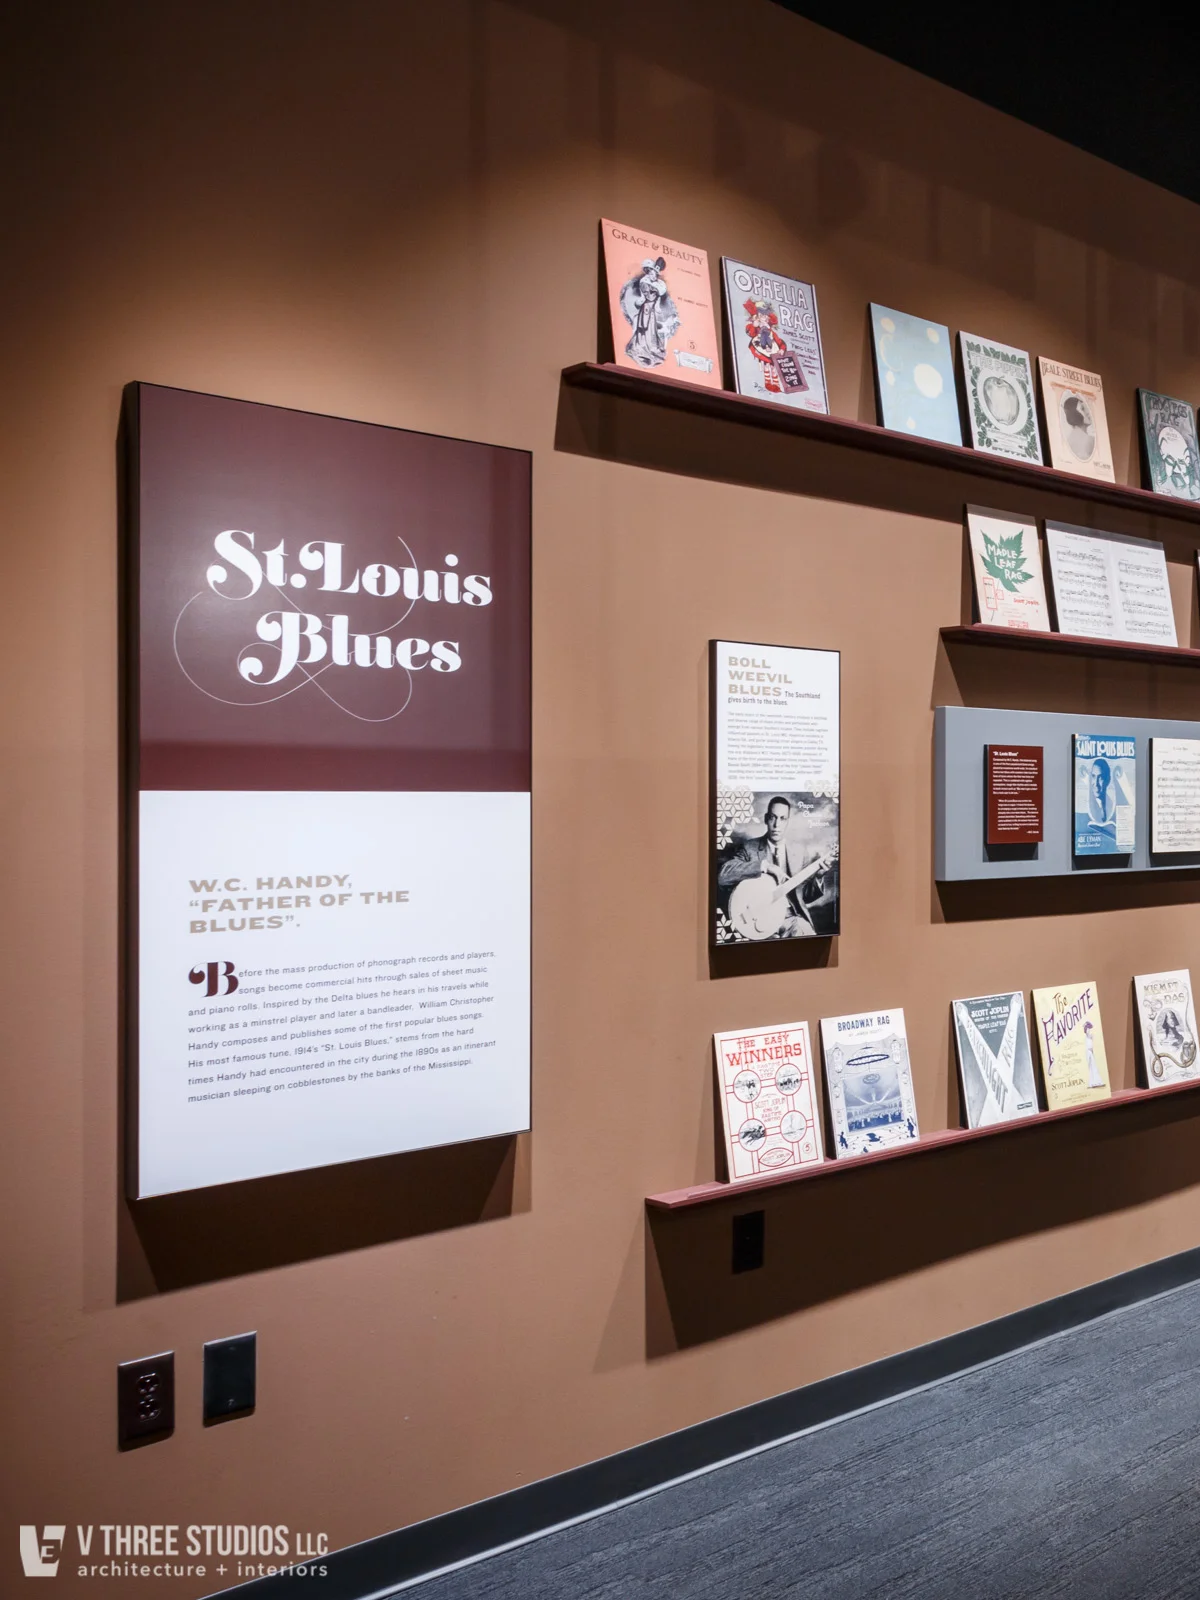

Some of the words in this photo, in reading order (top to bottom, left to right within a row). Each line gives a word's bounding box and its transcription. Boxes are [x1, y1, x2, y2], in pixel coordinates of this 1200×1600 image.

[612, 228, 649, 248] GRACE
[651, 242, 660, 250] &
[662, 244, 704, 266] BEAUTY
[733, 269, 808, 310] OPHELIA
[779, 304, 815, 333] RAG
[1062, 367, 1083, 384] STREET
[1084, 374, 1102, 391] BLUES
[298, 540, 494, 607] Louis
[994, 556, 1016, 570] LEAF
[238, 610, 463, 685] Blues
[728, 656, 771, 669] BOLL
[728, 669, 793, 684] WEEVIL
[727, 696, 742, 704] gives
[728, 684, 782, 697] BLUES
[784, 690, 794, 698] The
[795, 691, 821, 699] Southland
[1076, 740, 1096, 757] SAINT
[1097, 740, 1116, 757] LOUIS
[1116, 741, 1135, 757] BLUES
[188, 878, 248, 894] W.C.
[256, 874, 353, 890] HANDY,
[319, 893, 353, 907] OF
[359, 890, 410, 905] THE
[264, 966, 279, 976] the
[281, 966, 305, 974] mass
[307, 960, 354, 975] production
[356, 959, 365, 968] of
[367, 955, 416, 970] phonograph
[417, 952, 448, 964] records
[450, 951, 464, 961] and
[238, 985, 265, 996] songs
[267, 979, 303, 991] become
[305, 975, 354, 988] commercial
[356, 974, 372, 984] hits
[374, 971, 406, 985] through
[408, 969, 429, 979] sales
[431, 968, 439, 978] of
[441, 966, 463, 977] sheet
[464, 964, 487, 975] music
[187, 1006, 206, 1016] and
[208, 1003, 234, 1017] piano
[262, 997, 299, 1012] Inspired
[301, 995, 312, 1008] by
[314, 994, 328, 1004] the
[331, 991, 353, 1003] Delta
[355, 989, 378, 1000] blues
[380, 988, 390, 998] he
[392, 986, 415, 997] hears
[417, 985, 425, 994] in
[427, 983, 438, 993] his
[440, 981, 467, 992] travels
[469, 979, 488, 989] while
[1053, 992, 1068, 1014] The
[187, 1020, 226, 1035] working
[228, 1021, 240, 1029] as
[250, 1013, 287, 1026] minstrel
[289, 1010, 317, 1025] player
[318, 1009, 335, 1019] and
[337, 1006, 357, 1017] later
[418, 997, 447, 1009] William
[449, 992, 494, 1008] Christopher
[971, 1008, 989, 1018] SCOTT
[989, 1005, 1010, 1015] JOPLIN
[837, 1017, 874, 1032] BROADWAY
[877, 1015, 890, 1026] RAG
[1041, 988, 1094, 1076] FAVORITE
[736, 1039, 756, 1049] THE
[764, 1033, 789, 1046] EASY
[726, 1043, 802, 1067] WINNERS
